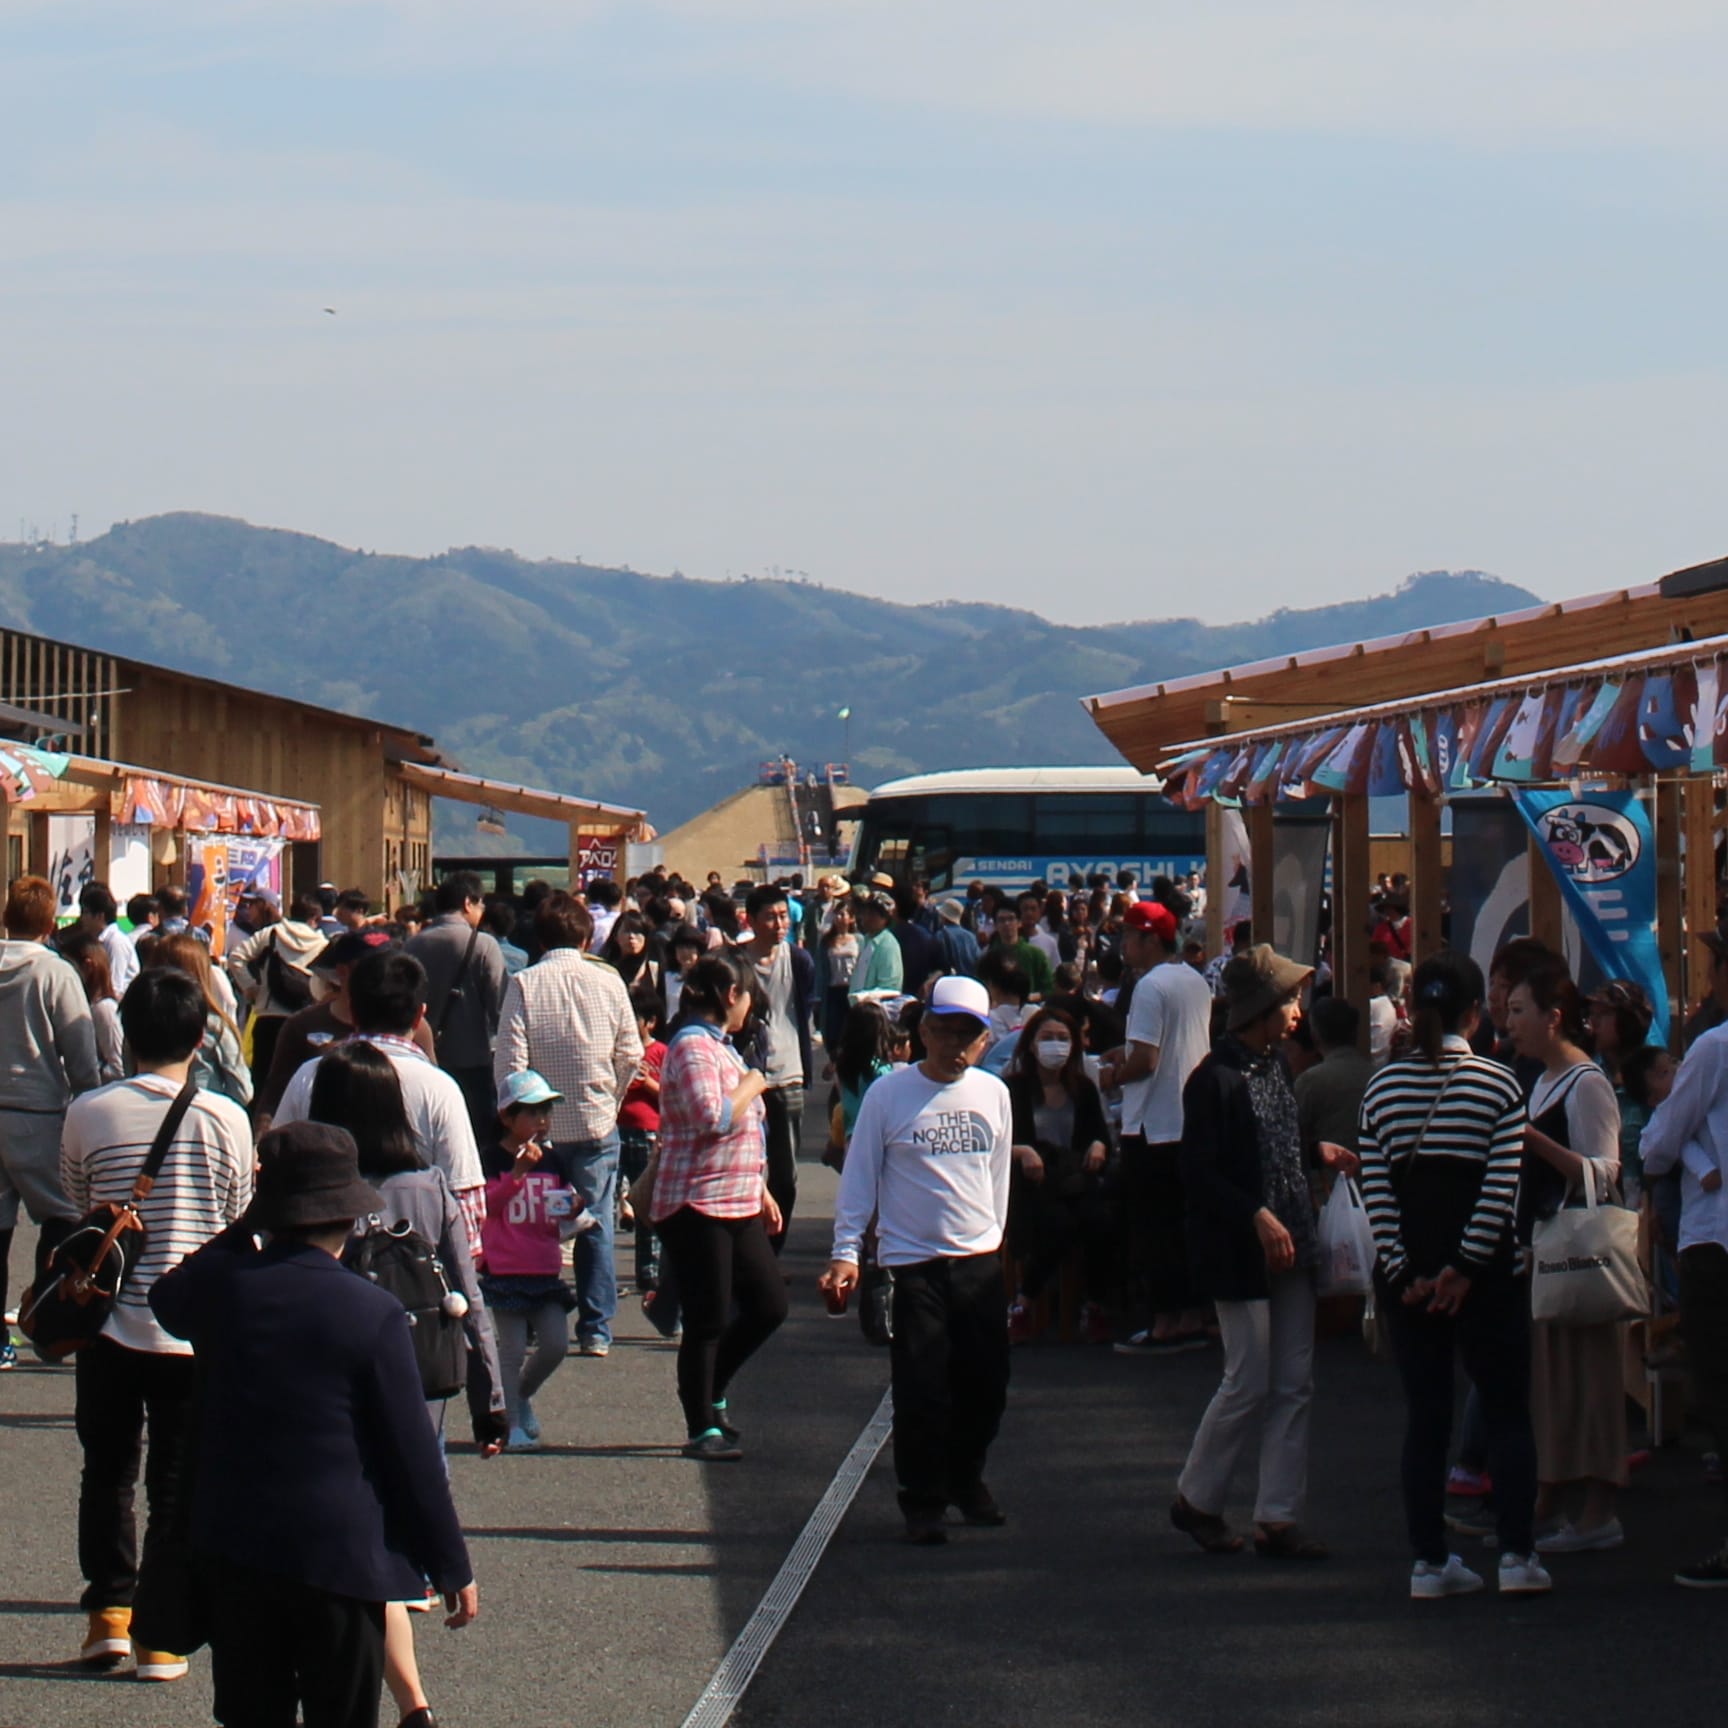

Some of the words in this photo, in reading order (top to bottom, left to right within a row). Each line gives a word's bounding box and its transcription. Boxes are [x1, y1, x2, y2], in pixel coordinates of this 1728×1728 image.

[978, 860, 1032, 871] SENDAI
[1046, 862, 1174, 884] AYASHI
[936, 1111, 969, 1125] THE
[913, 1124, 971, 1144] NORTH
[932, 1139, 971, 1155] FACE
